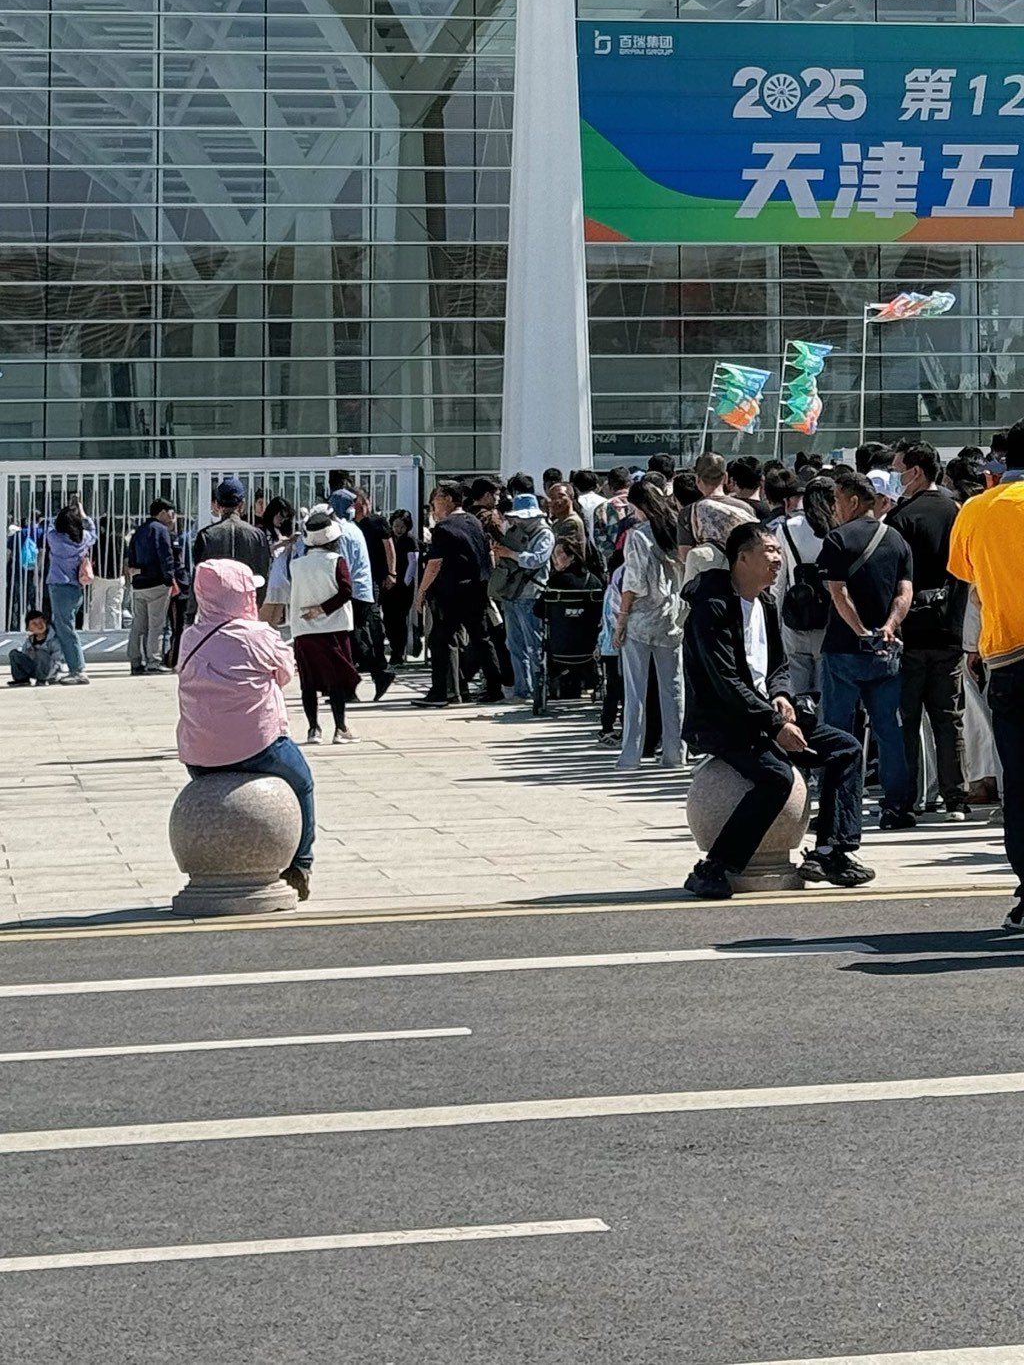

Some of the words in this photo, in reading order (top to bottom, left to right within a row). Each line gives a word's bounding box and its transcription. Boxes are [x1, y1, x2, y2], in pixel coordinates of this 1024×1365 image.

[619, 35, 673, 48] 百瑞集团
[732, 66, 868, 121] 2025
